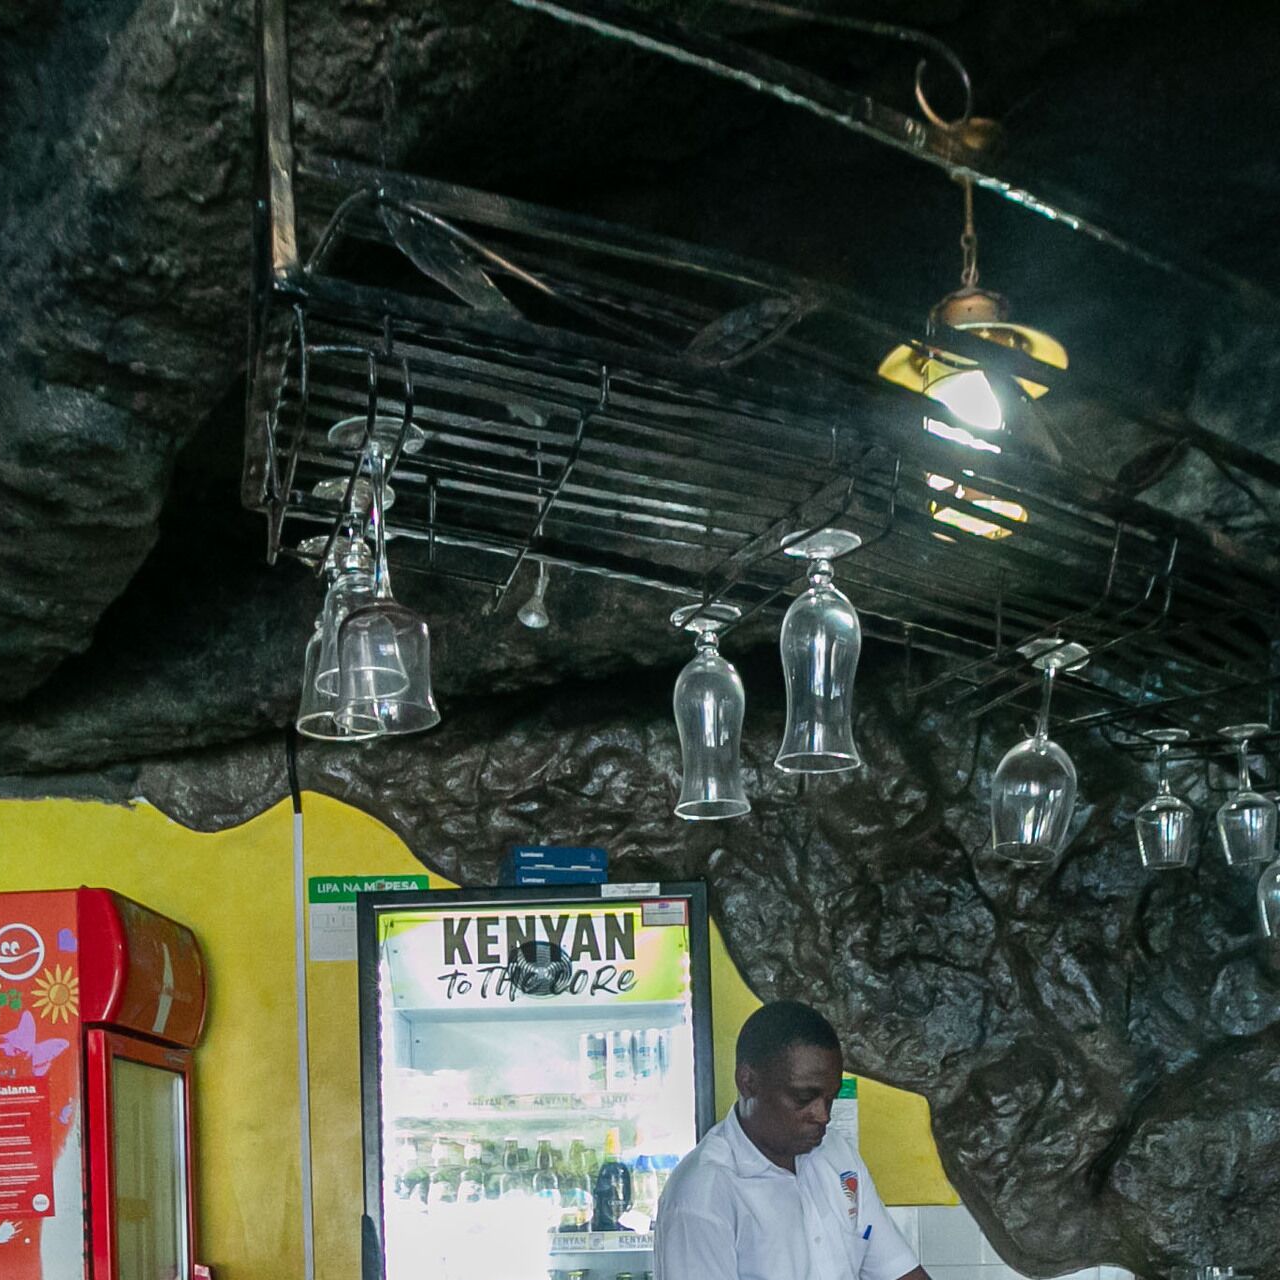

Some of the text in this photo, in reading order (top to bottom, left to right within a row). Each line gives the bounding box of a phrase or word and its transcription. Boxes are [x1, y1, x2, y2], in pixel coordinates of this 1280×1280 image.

[317, 883, 340, 894] LIPA
[343, 882, 361, 893] NA
[443, 912, 635, 965] KENYAN
